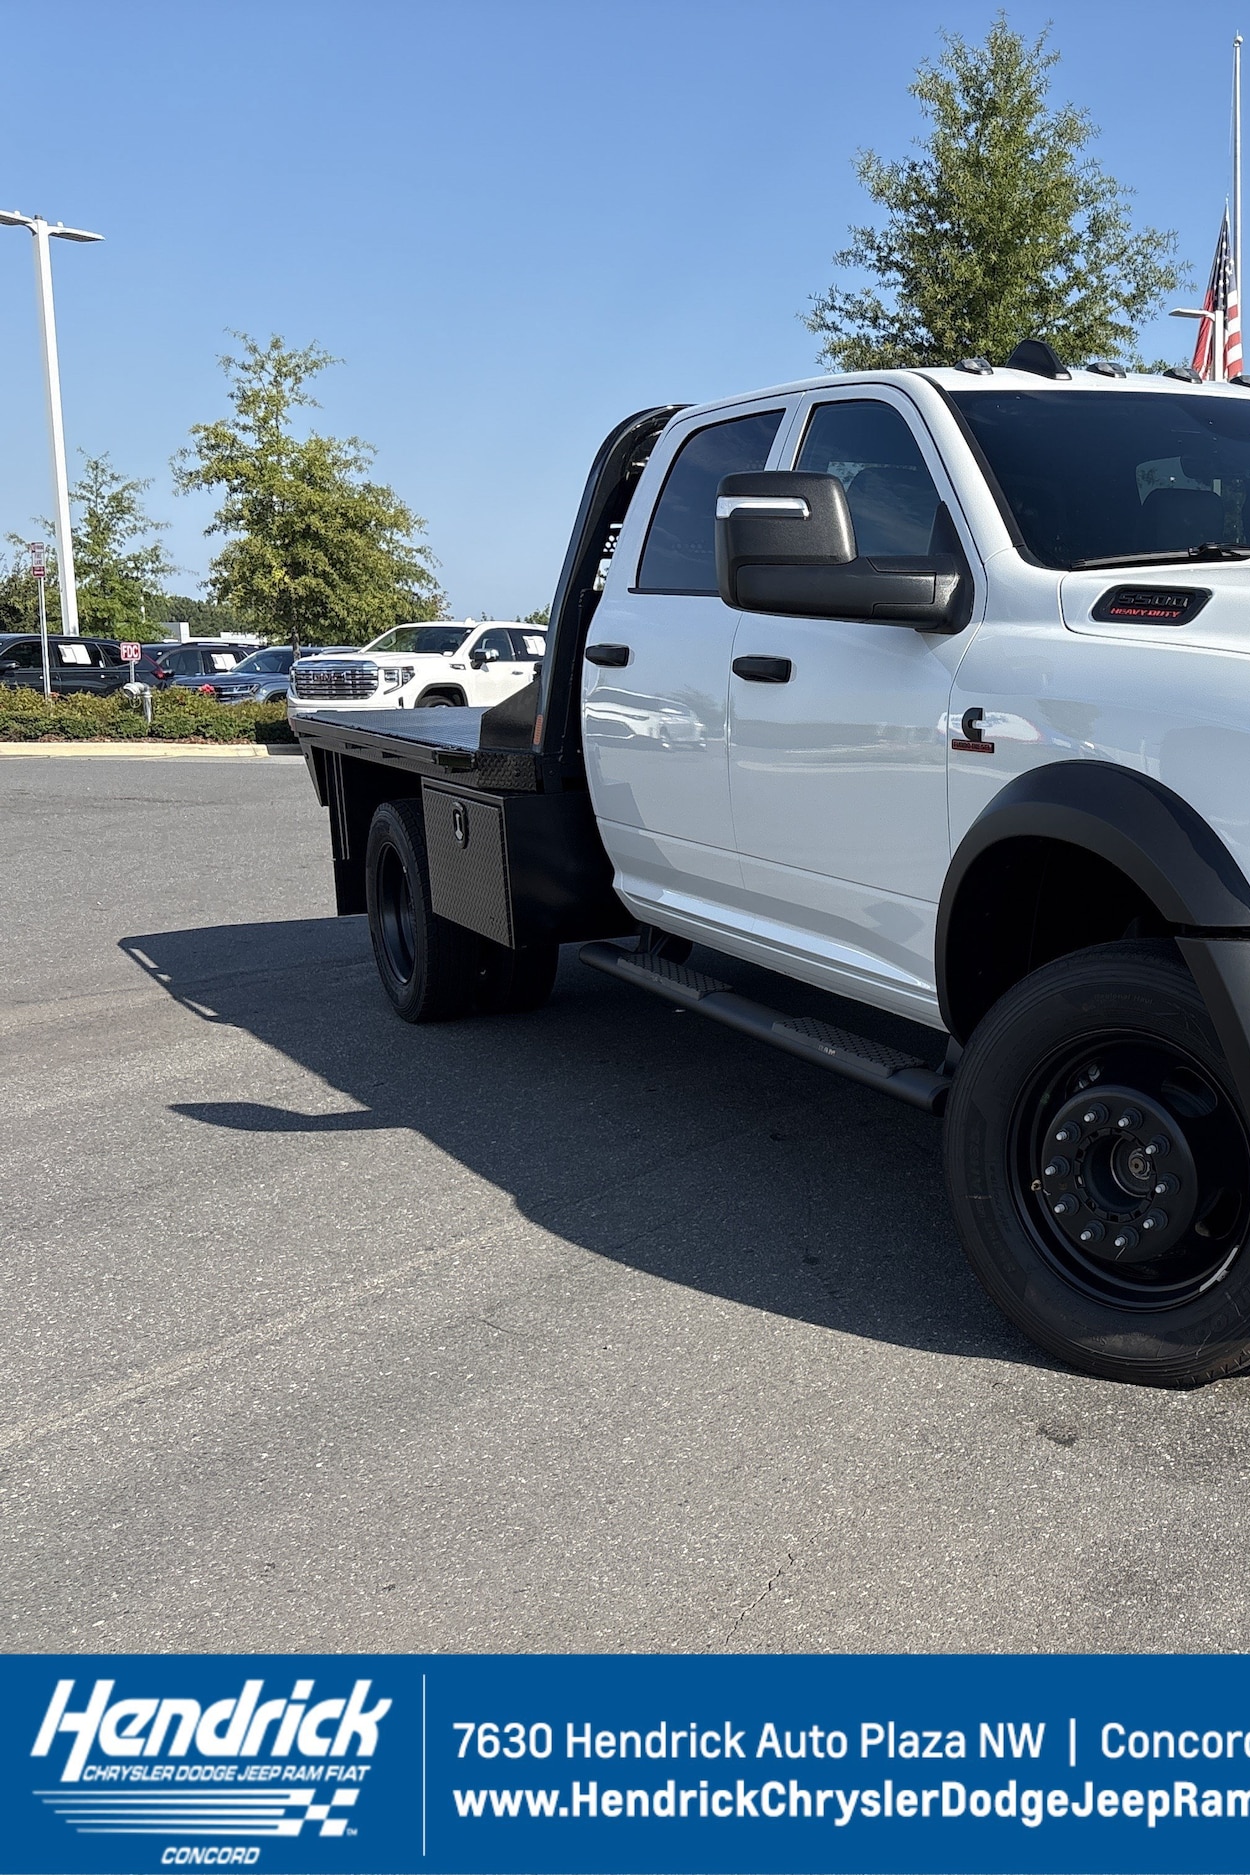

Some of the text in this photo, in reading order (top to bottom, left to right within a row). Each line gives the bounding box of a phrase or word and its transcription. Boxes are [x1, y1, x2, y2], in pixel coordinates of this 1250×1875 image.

[1118, 592, 1189, 608] 5500
[1110, 607, 1183, 618] HEAVY DUTY
[122, 645, 139, 658] FDC
